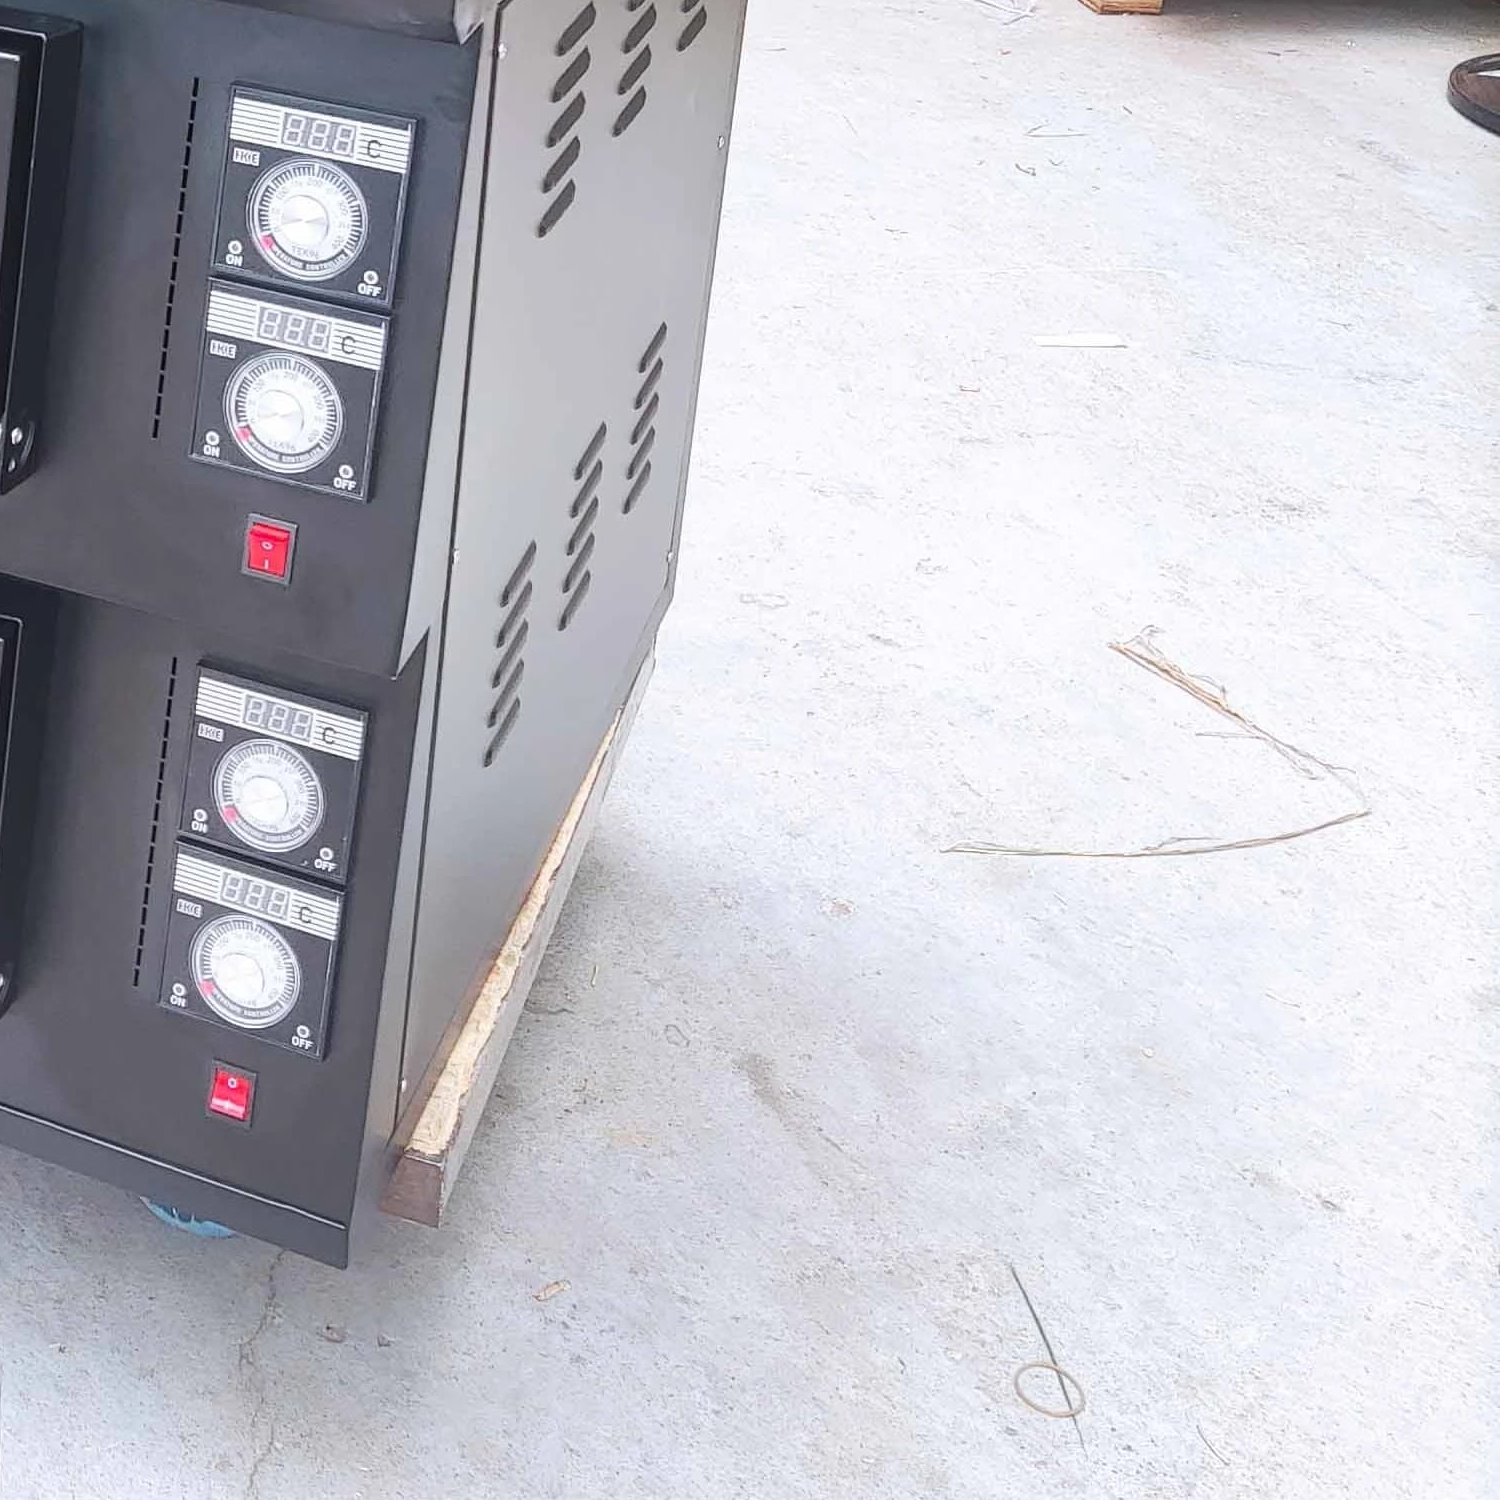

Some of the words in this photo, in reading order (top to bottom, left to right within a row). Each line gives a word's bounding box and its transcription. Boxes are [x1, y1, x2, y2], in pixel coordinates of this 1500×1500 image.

[225, 253, 243, 267] ON
[357, 283, 382, 297] OFF
[203, 444, 221, 458] ON
[333, 476, 357, 491] OFF
[191, 820, 209, 834] ON
[314, 858, 338, 873] OFF
[169, 994, 187, 1008] ON
[291, 1035, 314, 1051] OFF
